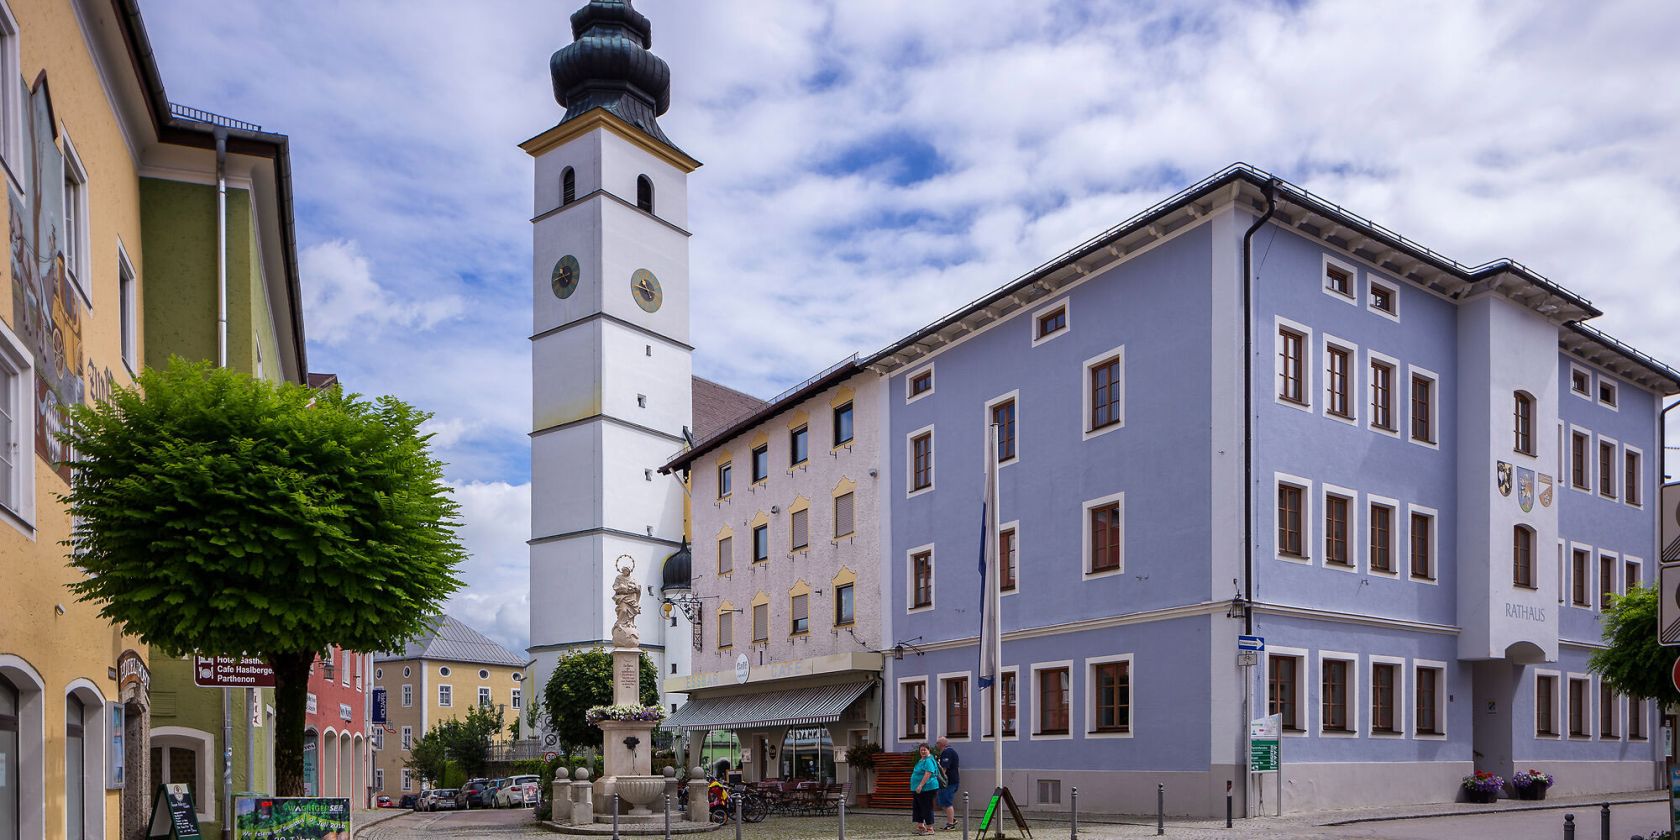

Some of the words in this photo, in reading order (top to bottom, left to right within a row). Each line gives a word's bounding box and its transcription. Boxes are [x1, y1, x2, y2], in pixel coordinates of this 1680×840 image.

[1505, 602, 1546, 622] RATHAUS
[217, 665, 235, 673] Cafe
[236, 665, 274, 676] Haslberge
[217, 674, 256, 683] Parthenon
